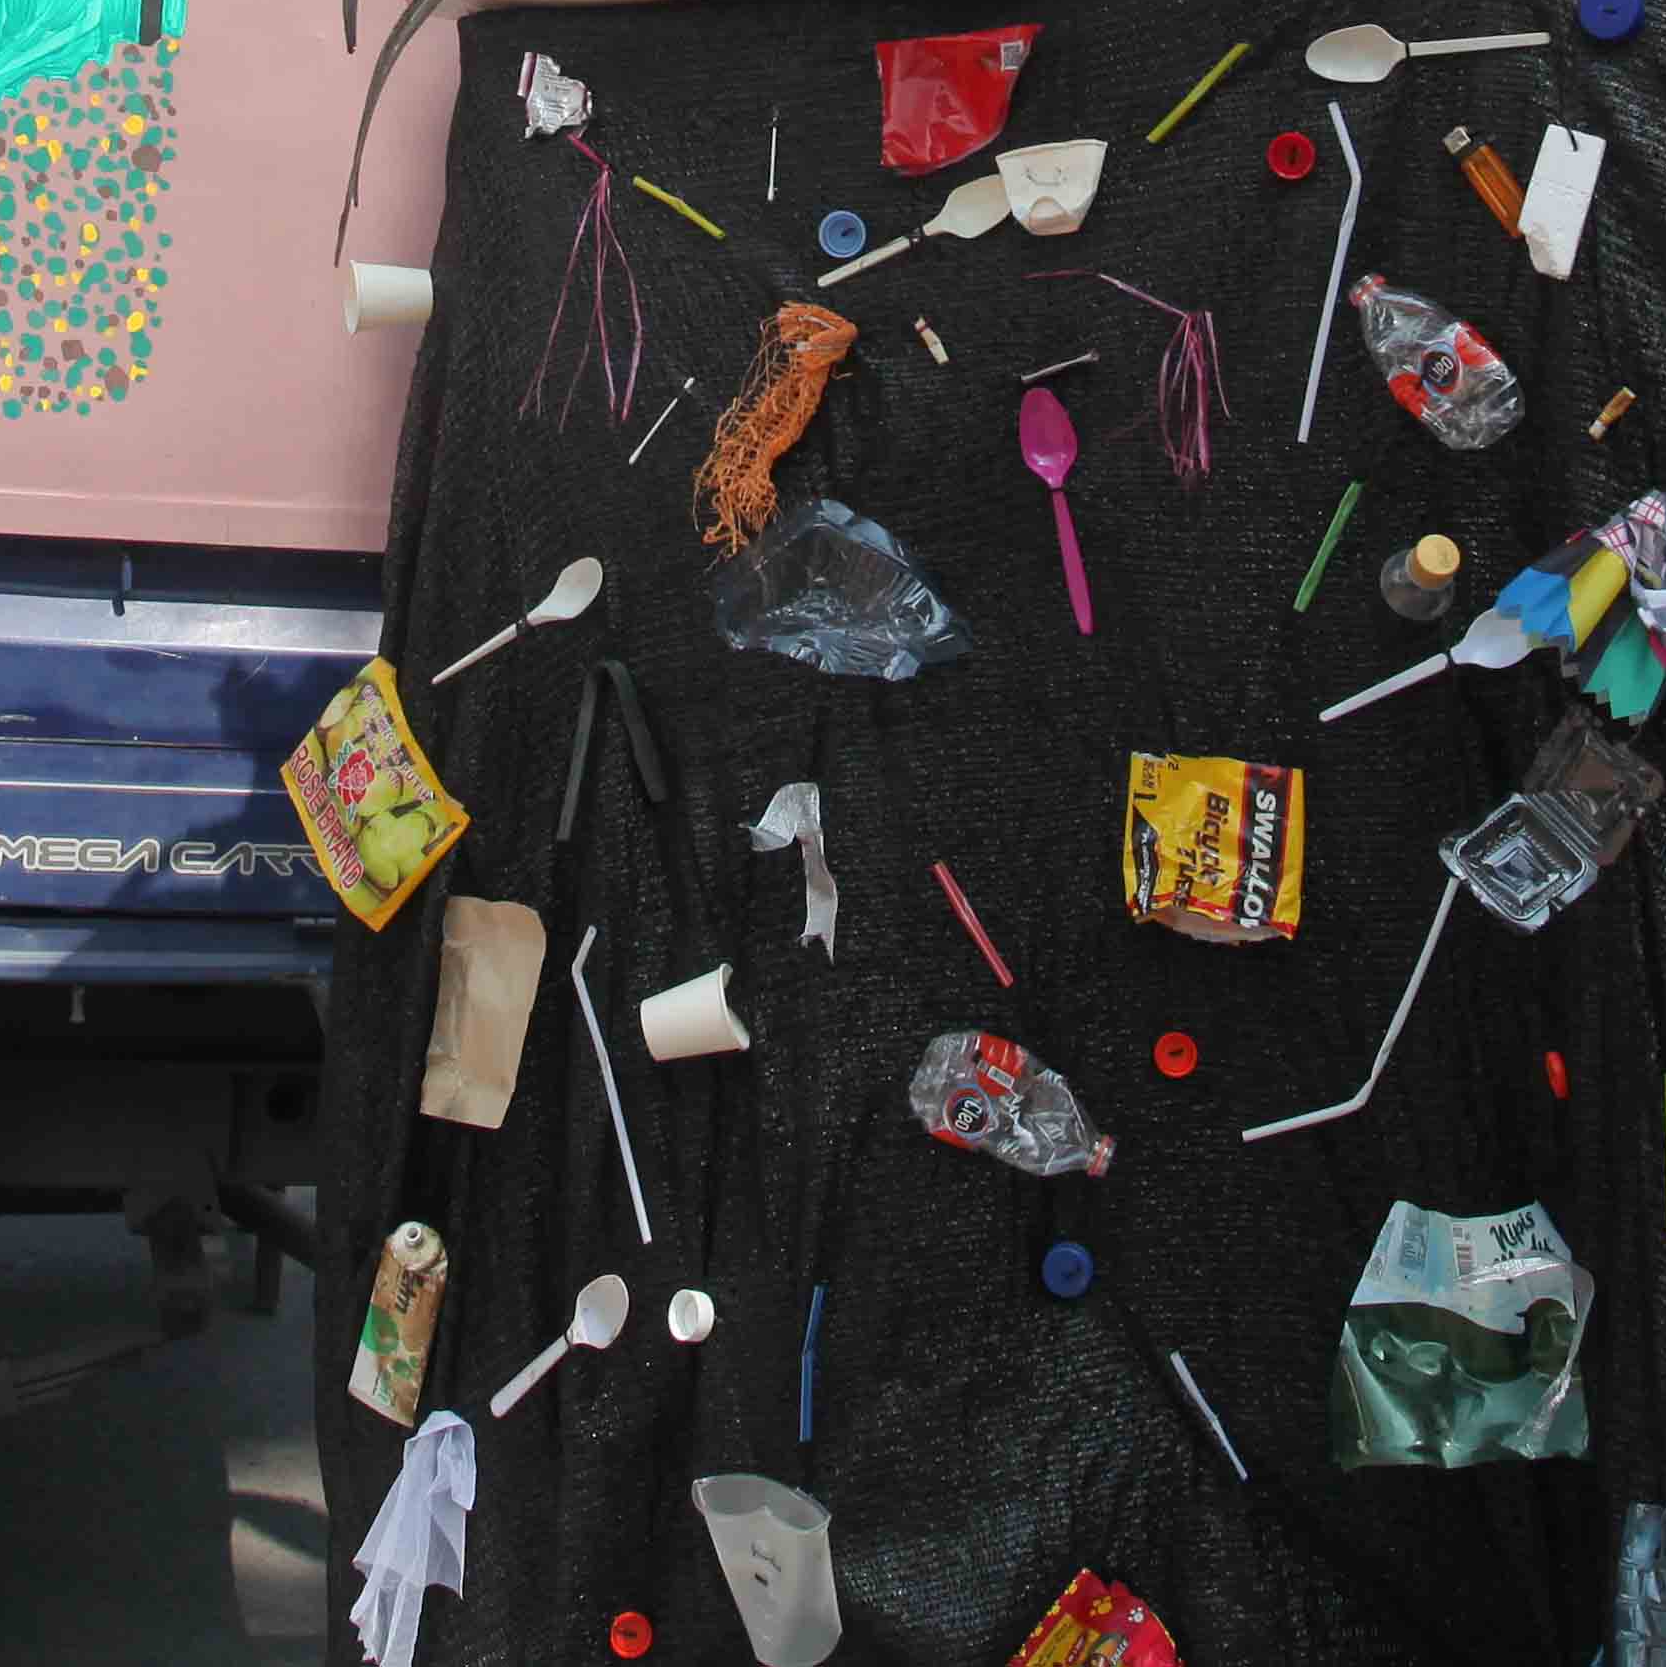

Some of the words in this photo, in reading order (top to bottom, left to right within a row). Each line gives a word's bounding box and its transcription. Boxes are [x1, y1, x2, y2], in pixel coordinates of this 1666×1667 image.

[288, 742, 328, 815] ROSE
[317, 804, 366, 892] BRAND
[954, 1099, 982, 1133] Cleo
